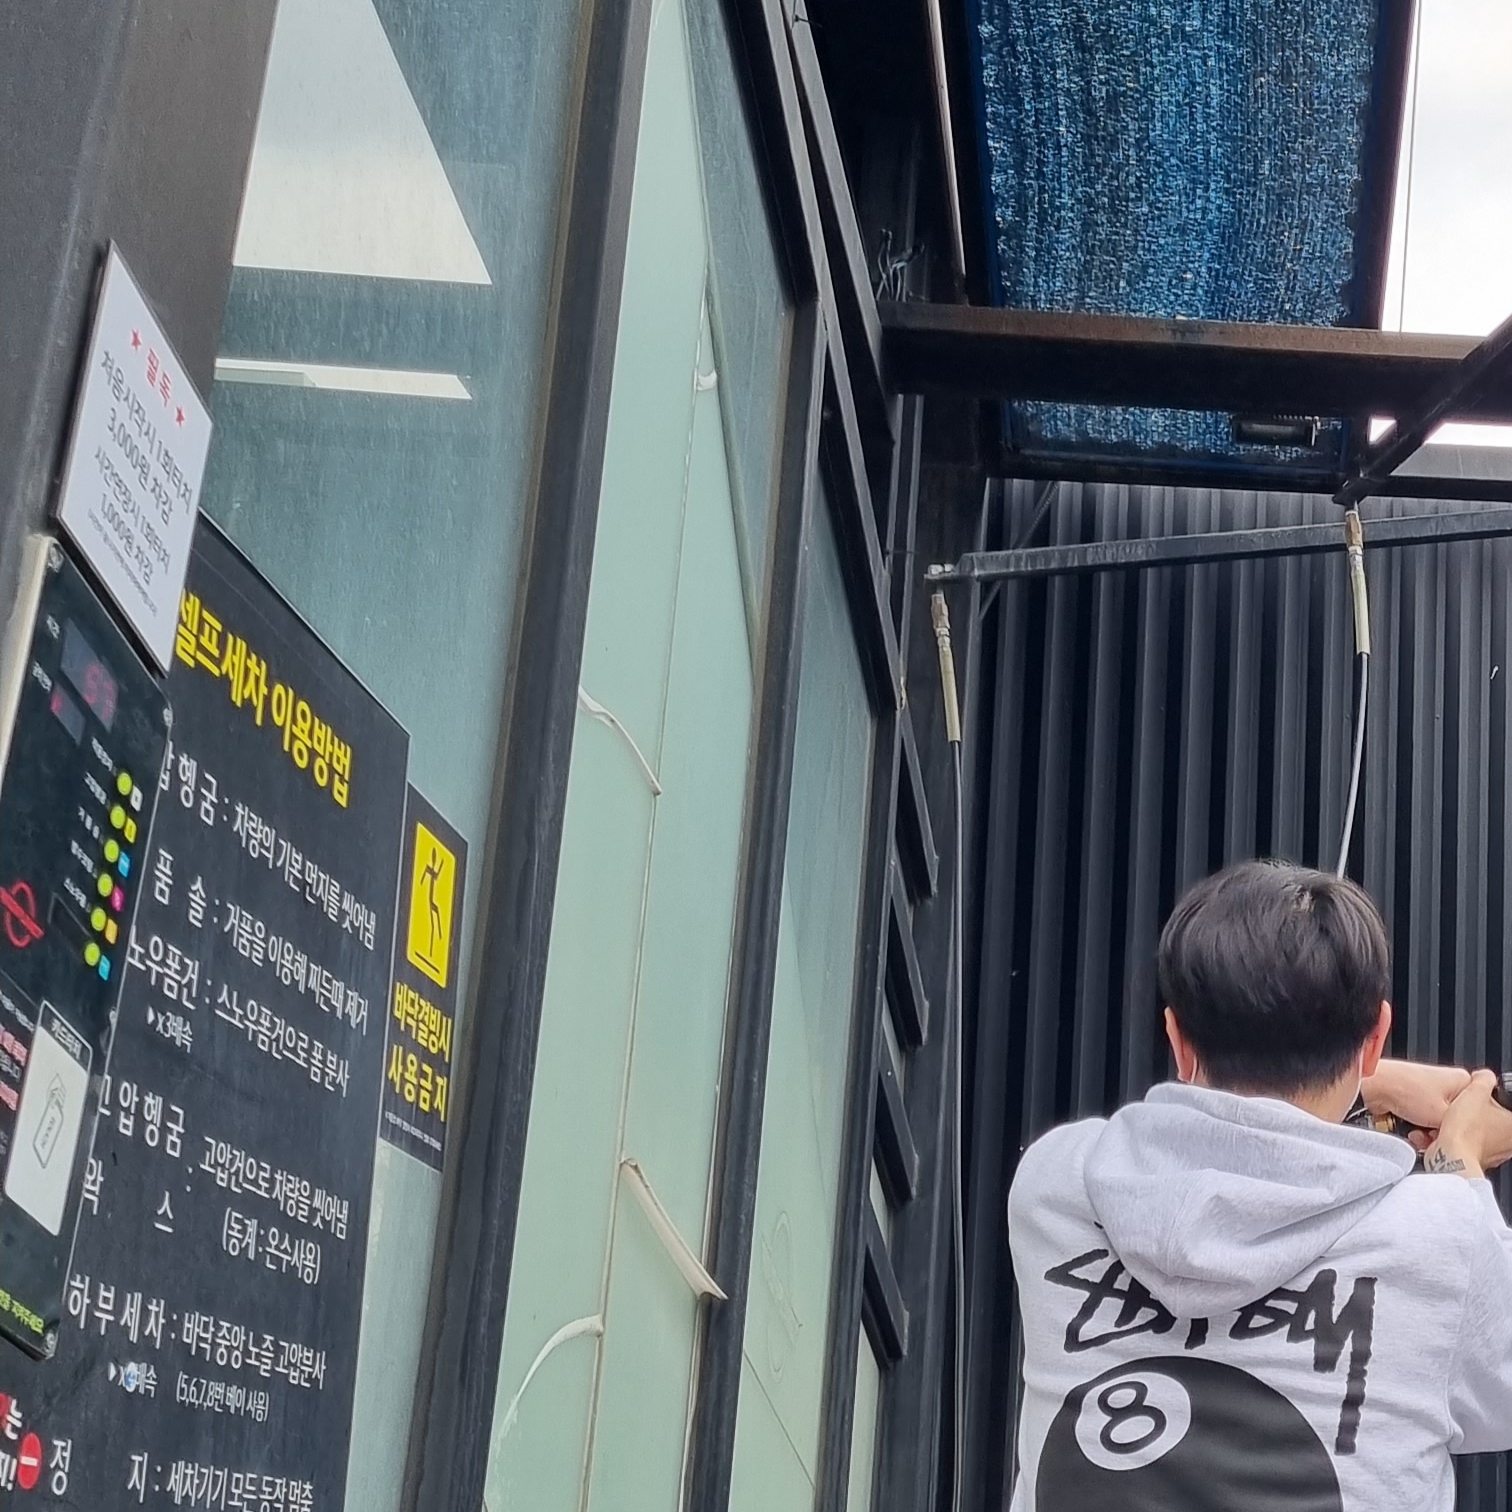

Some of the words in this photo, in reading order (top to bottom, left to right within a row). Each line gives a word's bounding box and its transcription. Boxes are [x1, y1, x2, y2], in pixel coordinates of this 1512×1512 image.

[107, 407, 150, 491] 3,000원
[150, 477, 172, 526] 차감
[134, 545, 153, 585] 차감
[175, 588, 267, 725] 셀프세차
[271, 683, 350, 807] 이용방법
[233, 802, 275, 868] 차량의
[276, 838, 302, 891] 기본
[305, 860, 340, 922] 먼지를
[341, 891, 375, 950] 씻어냄
[223, 903, 265, 967] 거품을
[268, 935, 307, 994] 이용해
[344, 989, 368, 1035] 제거
[215, 984, 308, 1068] 스노우폼건으로
[310, 1040, 323, 1082] 폼
[324, 1050, 349, 1097] 분사
[393, 982, 451, 1062] 바닥결빙시
[388, 1044, 447, 1121] 사용금지
[199, 1136, 270, 1198] 고압건으로
[271, 1169, 310, 1223] 차량을
[312, 1188, 348, 1239] 씻어냄
[182, 1311, 214, 1361] 바닥
[215, 1320, 245, 1368] 중앙
[245, 1331, 274, 1377] 노즐
[274, 1341, 326, 1389] 고압분사
[245, 1390, 269, 1422] 사용)
[1097, 1380, 1168, 1455] 8
[166, 1460, 227, 1510] 세차기기
